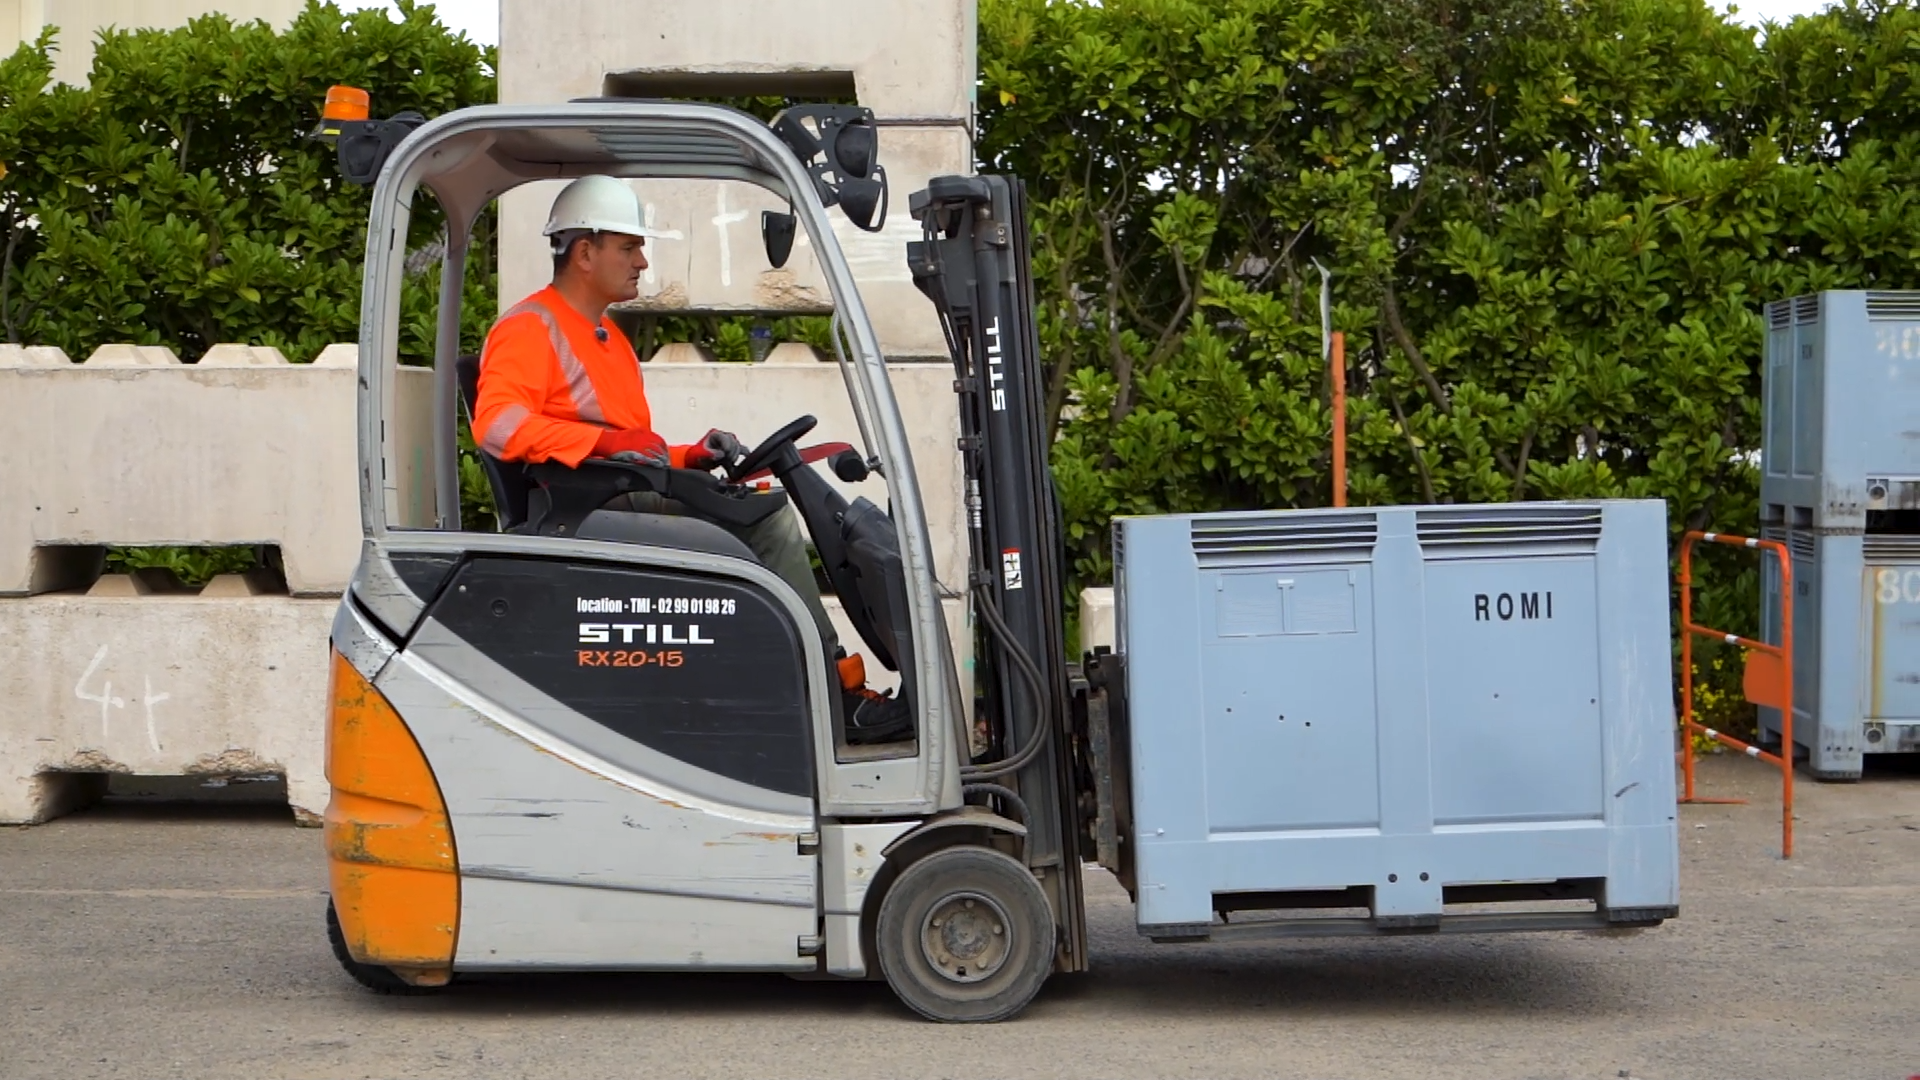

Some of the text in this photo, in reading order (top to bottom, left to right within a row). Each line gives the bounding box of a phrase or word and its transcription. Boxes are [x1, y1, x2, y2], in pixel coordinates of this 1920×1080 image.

[985, 315, 1007, 412] STILL
[577, 597, 623, 613] location
[630, 597, 651, 613] TMI
[658, 597, 673, 614] 02
[674, 598, 689, 614] 99
[690, 598, 703, 614] 01
[704, 598, 720, 615] 98
[721, 599, 736, 615] 26
[1474, 591, 1553, 621] ROMI
[578, 623, 715, 645] STILL
[578, 650, 685, 667] RX20-15
